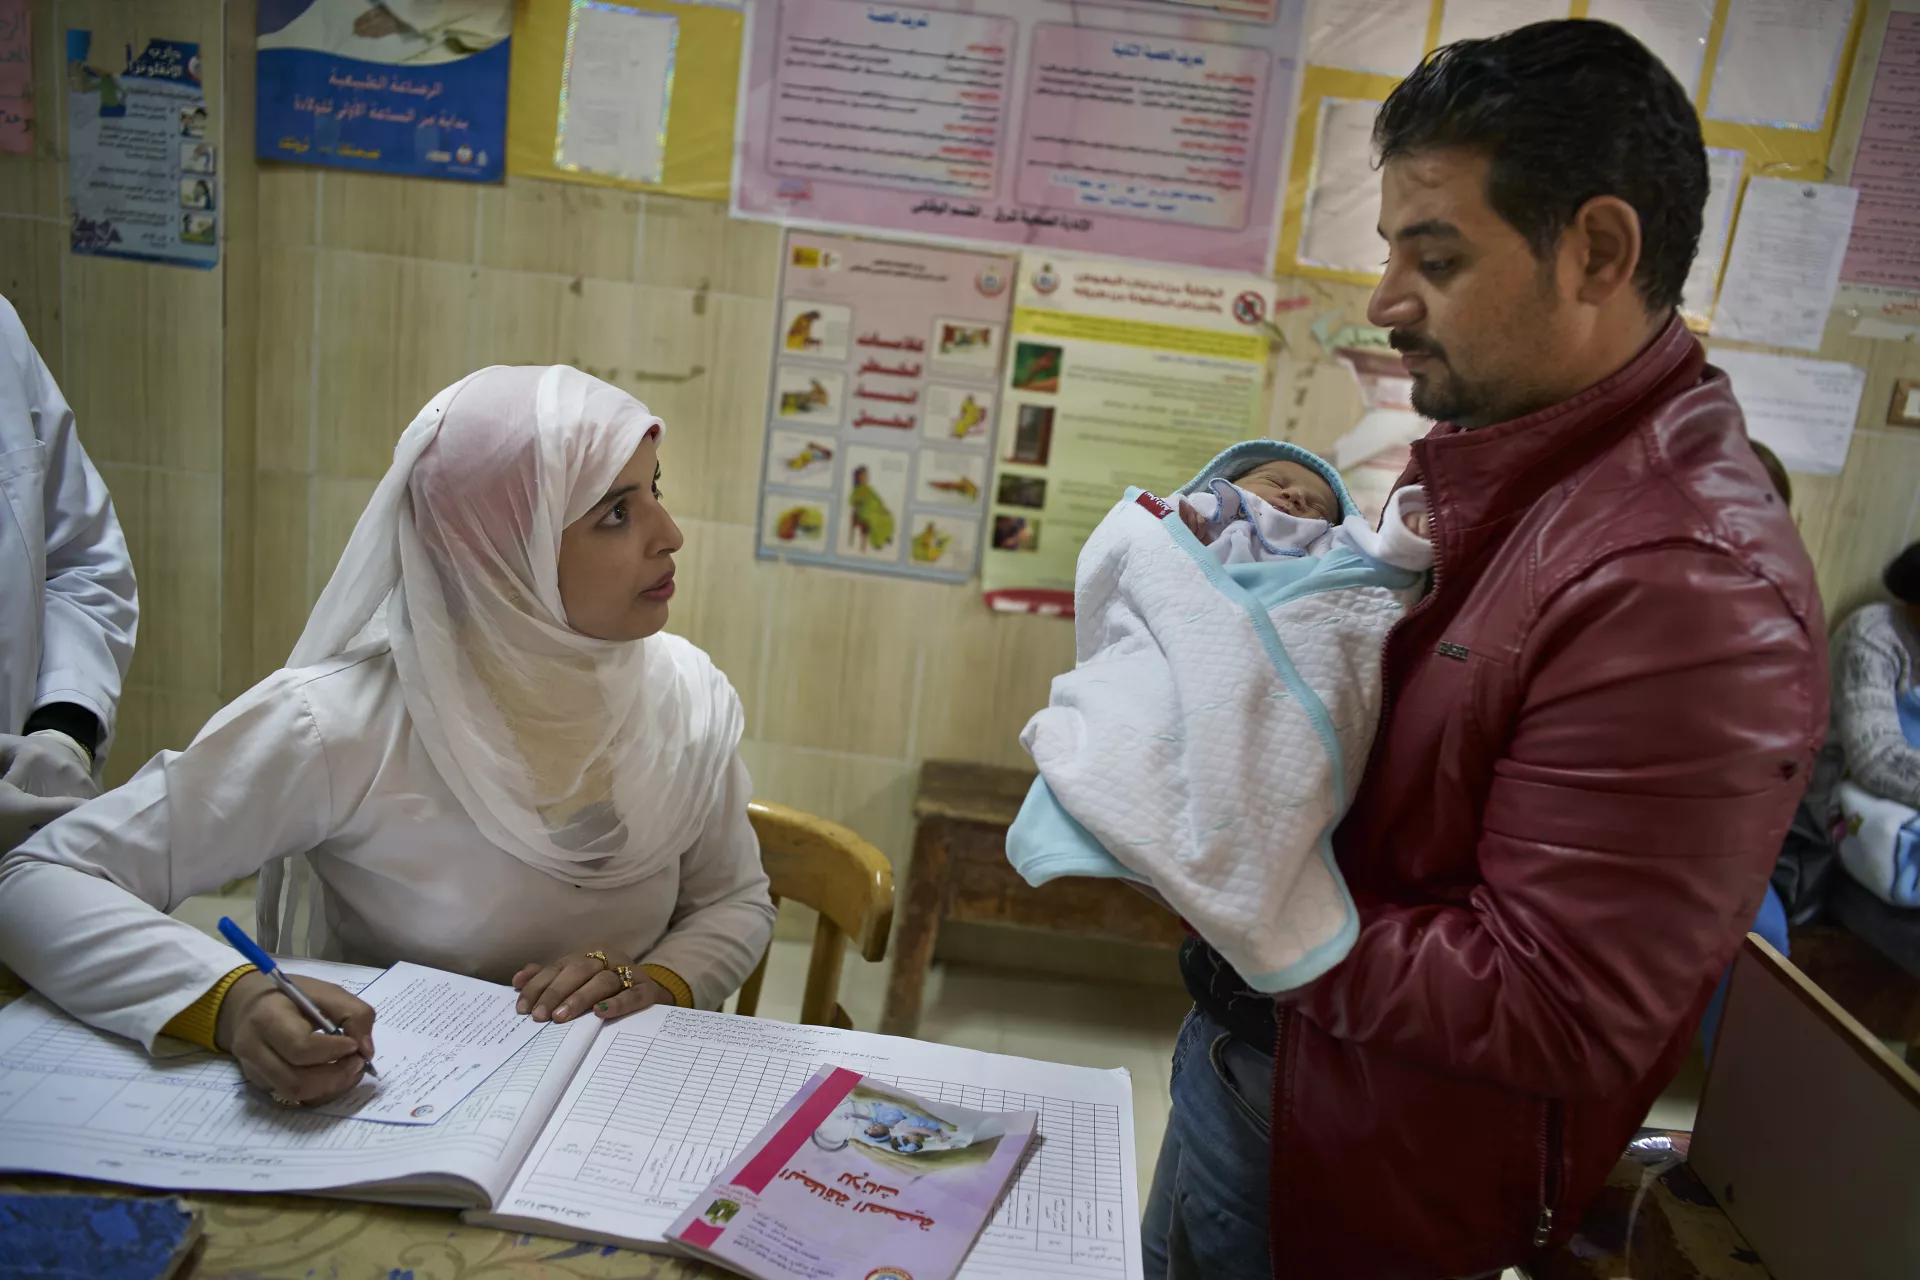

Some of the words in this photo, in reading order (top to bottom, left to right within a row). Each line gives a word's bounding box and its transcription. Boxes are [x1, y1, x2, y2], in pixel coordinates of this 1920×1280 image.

[837, 1171, 899, 1198] للإناث
[536, 1203, 559, 1213] الصحة
[779, 1168, 850, 1206] البطاقة
[853, 1200, 936, 1232] الصحية
